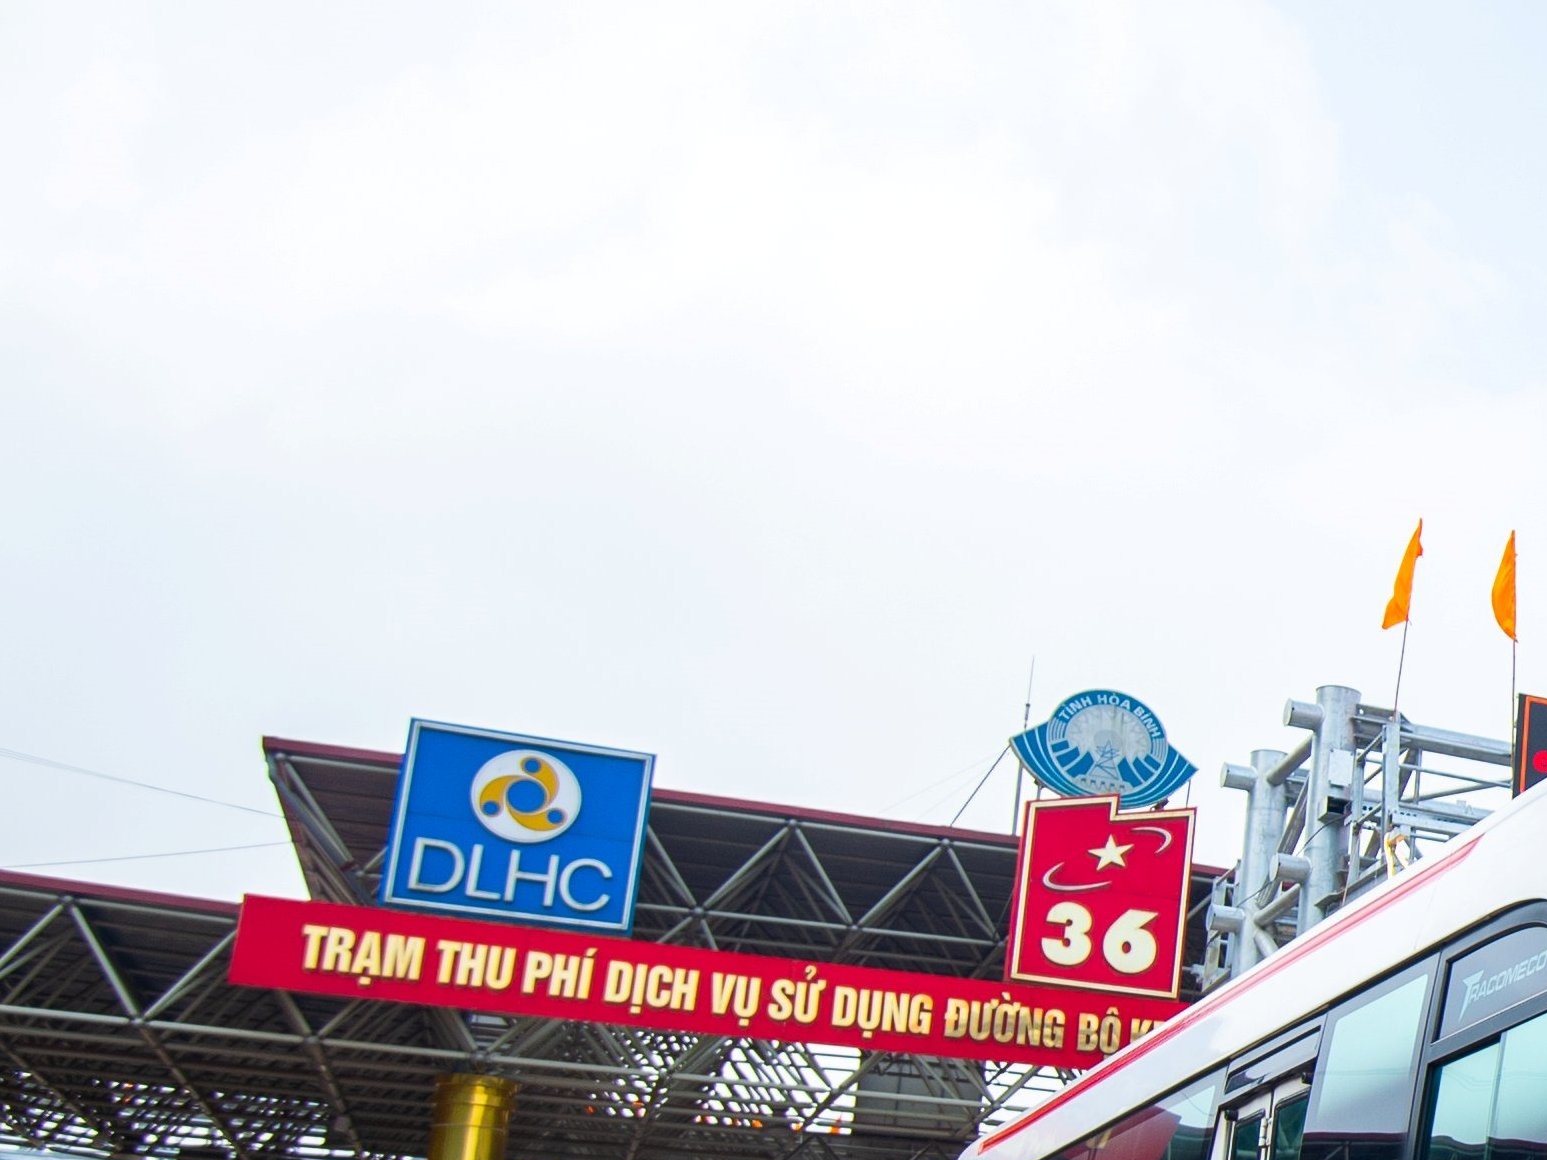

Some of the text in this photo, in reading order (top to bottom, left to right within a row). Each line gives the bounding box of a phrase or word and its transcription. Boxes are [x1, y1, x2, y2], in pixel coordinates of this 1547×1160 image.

[408, 837, 613, 912] DLHC
[1041, 901, 1159, 974] 36
[302, 924, 426, 986] TRẠM
[436, 939, 518, 992] THU
[521, 947, 597, 1001] PHÍ
[603, 961, 701, 1015] DỊCH
[710, 972, 762, 1026] VỤ
[767, 965, 826, 1024] SỬ
[831, 986, 934, 1039] DỤNG
[943, 992, 1066, 1049] ĐƯỜNG
